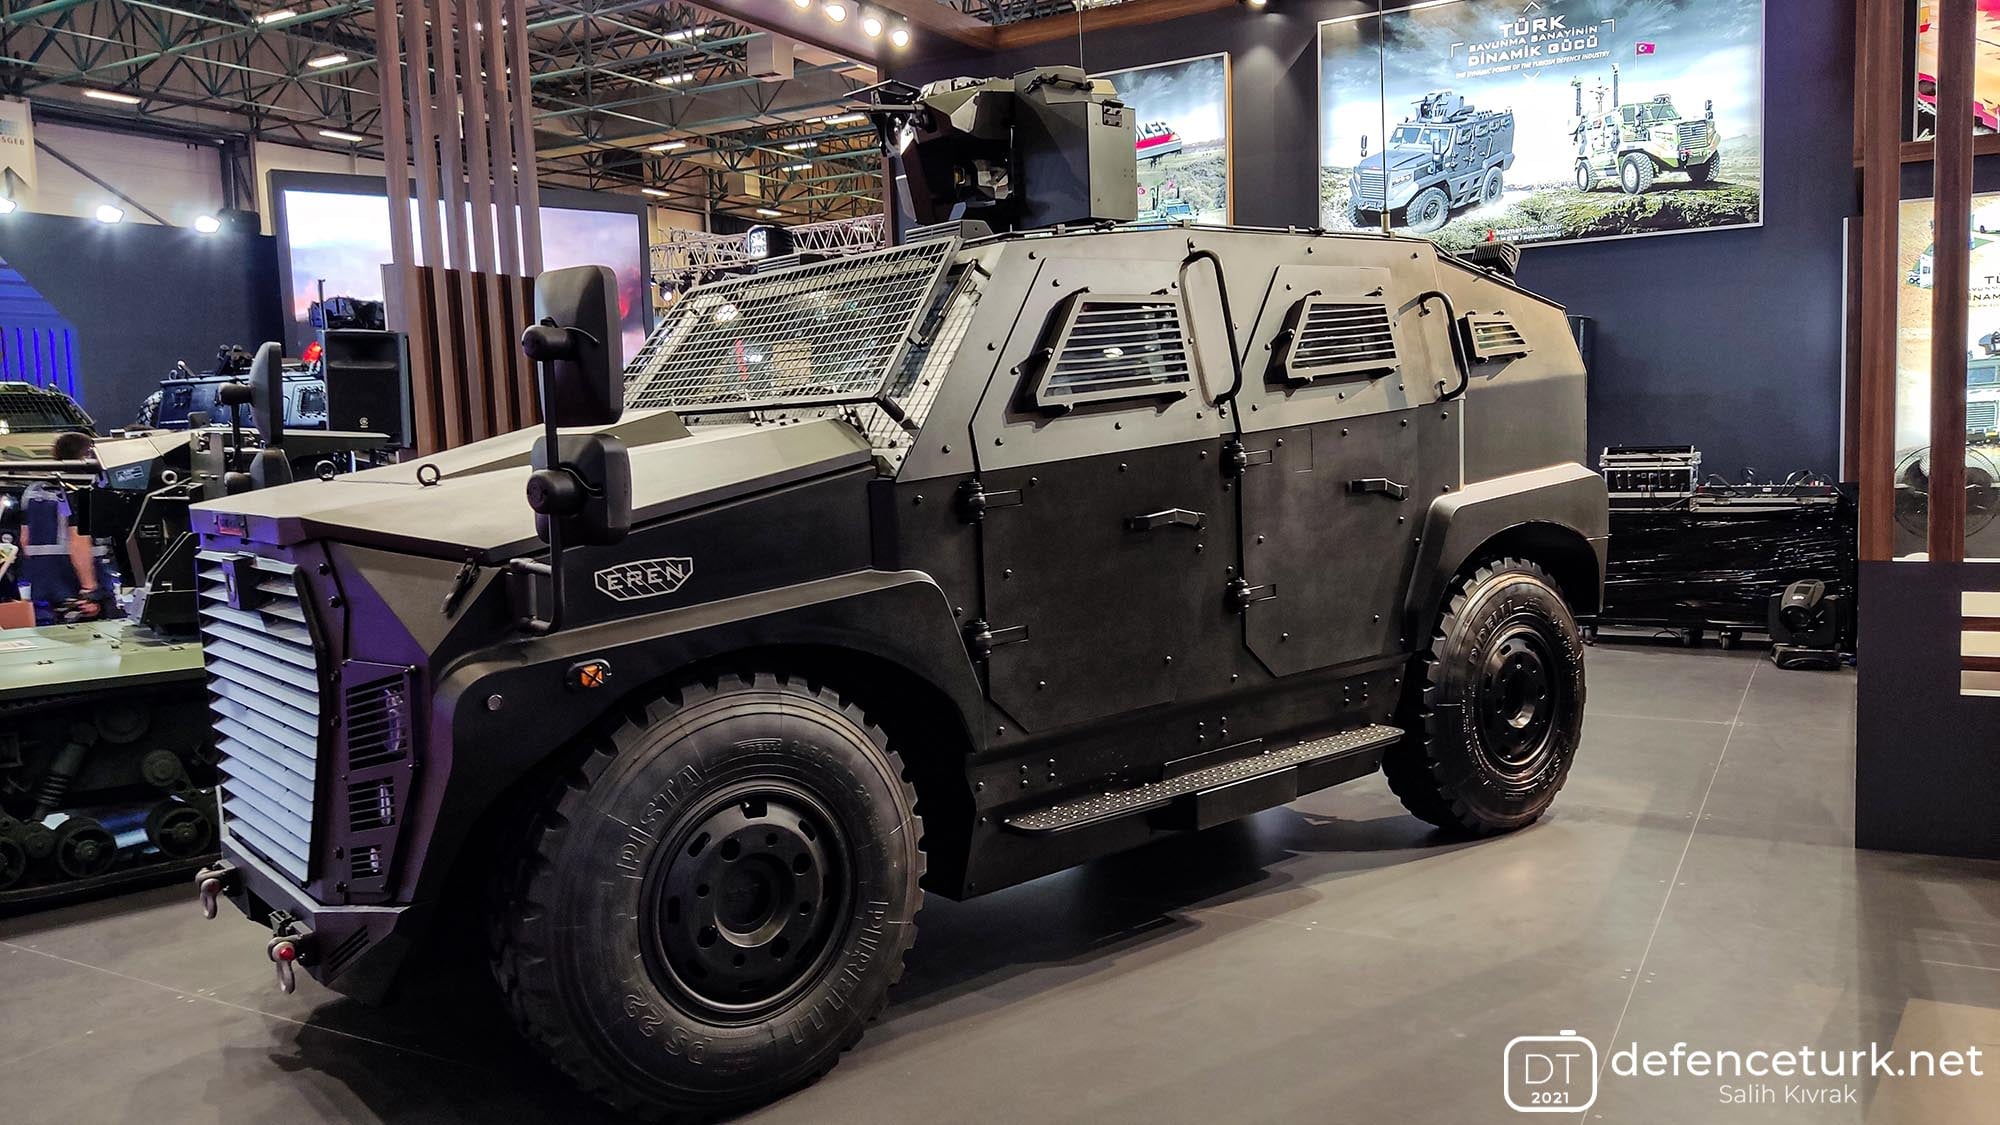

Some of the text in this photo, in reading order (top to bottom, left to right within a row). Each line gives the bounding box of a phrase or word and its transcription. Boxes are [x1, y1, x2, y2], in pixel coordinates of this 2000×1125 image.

[1499, 15, 1566, 38] TÜRK
[1468, 35, 1598, 67] DİNAMİK GÜCÜ
[1469, 38, 1527, 53] SAVUNMA
[1556, 55, 1582, 64] DEFENCE
[1581, 50, 1611, 62] INDUSTRY
[607, 564, 683, 590] EREN
